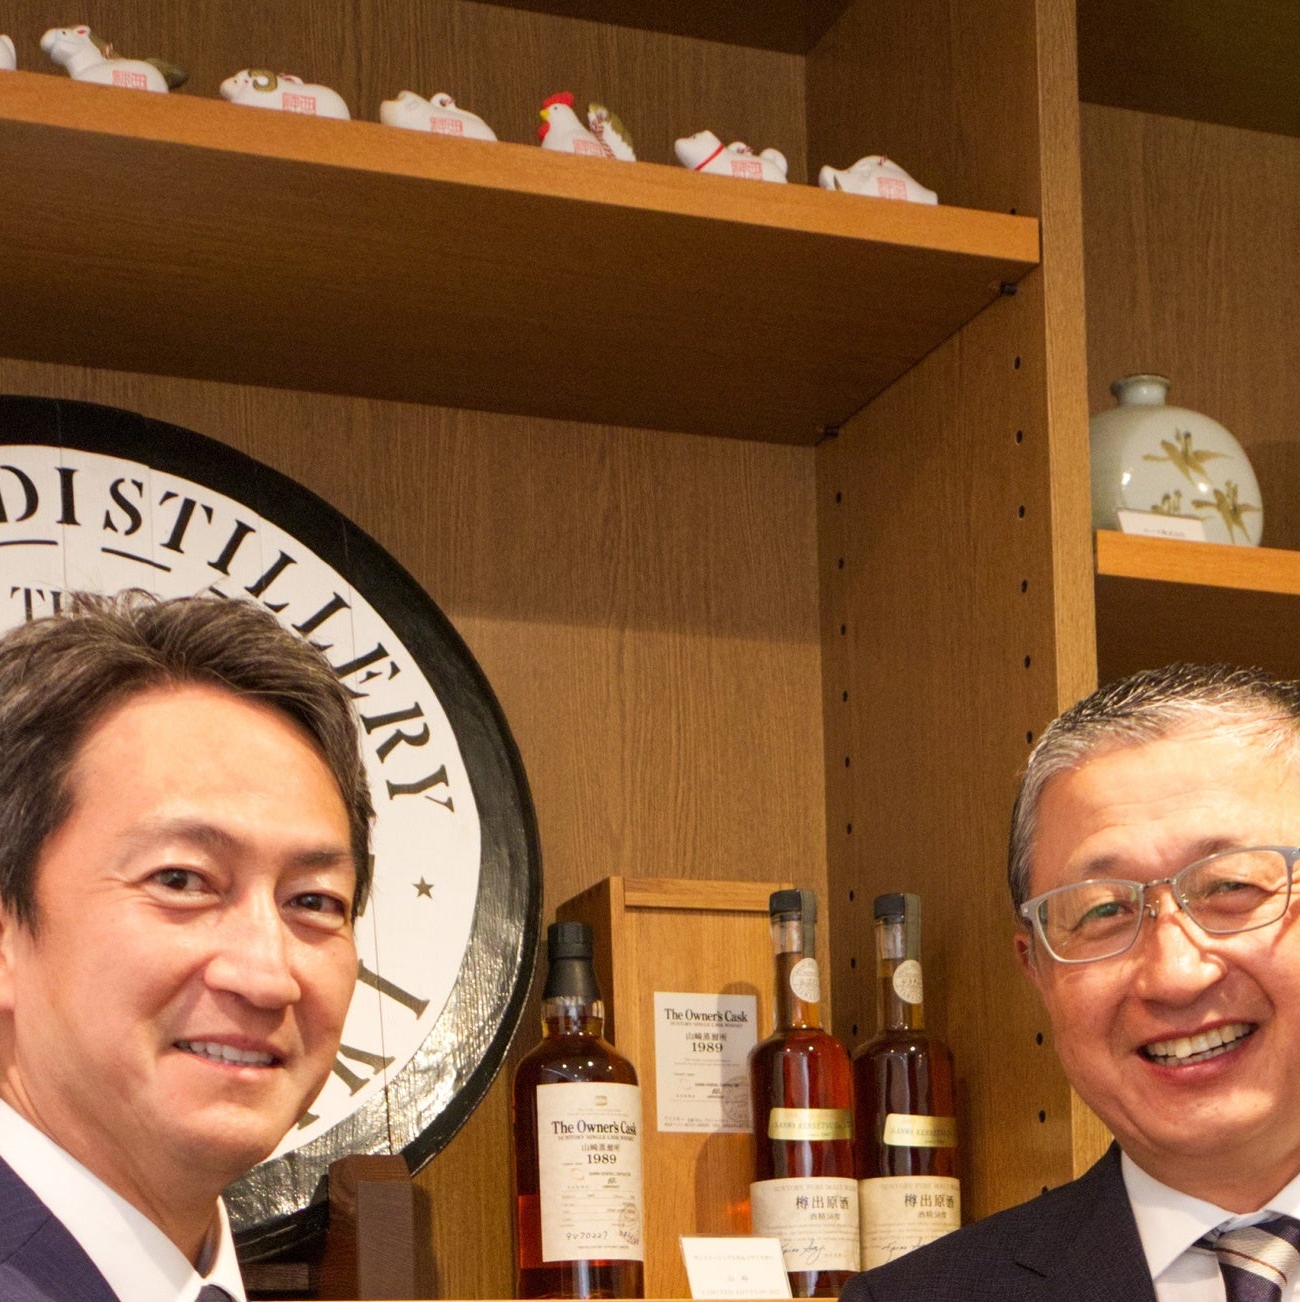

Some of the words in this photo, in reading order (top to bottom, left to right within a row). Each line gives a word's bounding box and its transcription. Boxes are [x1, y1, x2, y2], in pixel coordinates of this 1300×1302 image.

[664, 1008, 683, 1020] The
[685, 1009, 723, 1021] Owner's
[724, 1010, 748, 1022] Cask
[692, 1042, 724, 1053] 1989
[551, 1121, 575, 1134] The
[577, 1120, 620, 1133] Owner's
[587, 1154, 617, 1164] 1989
